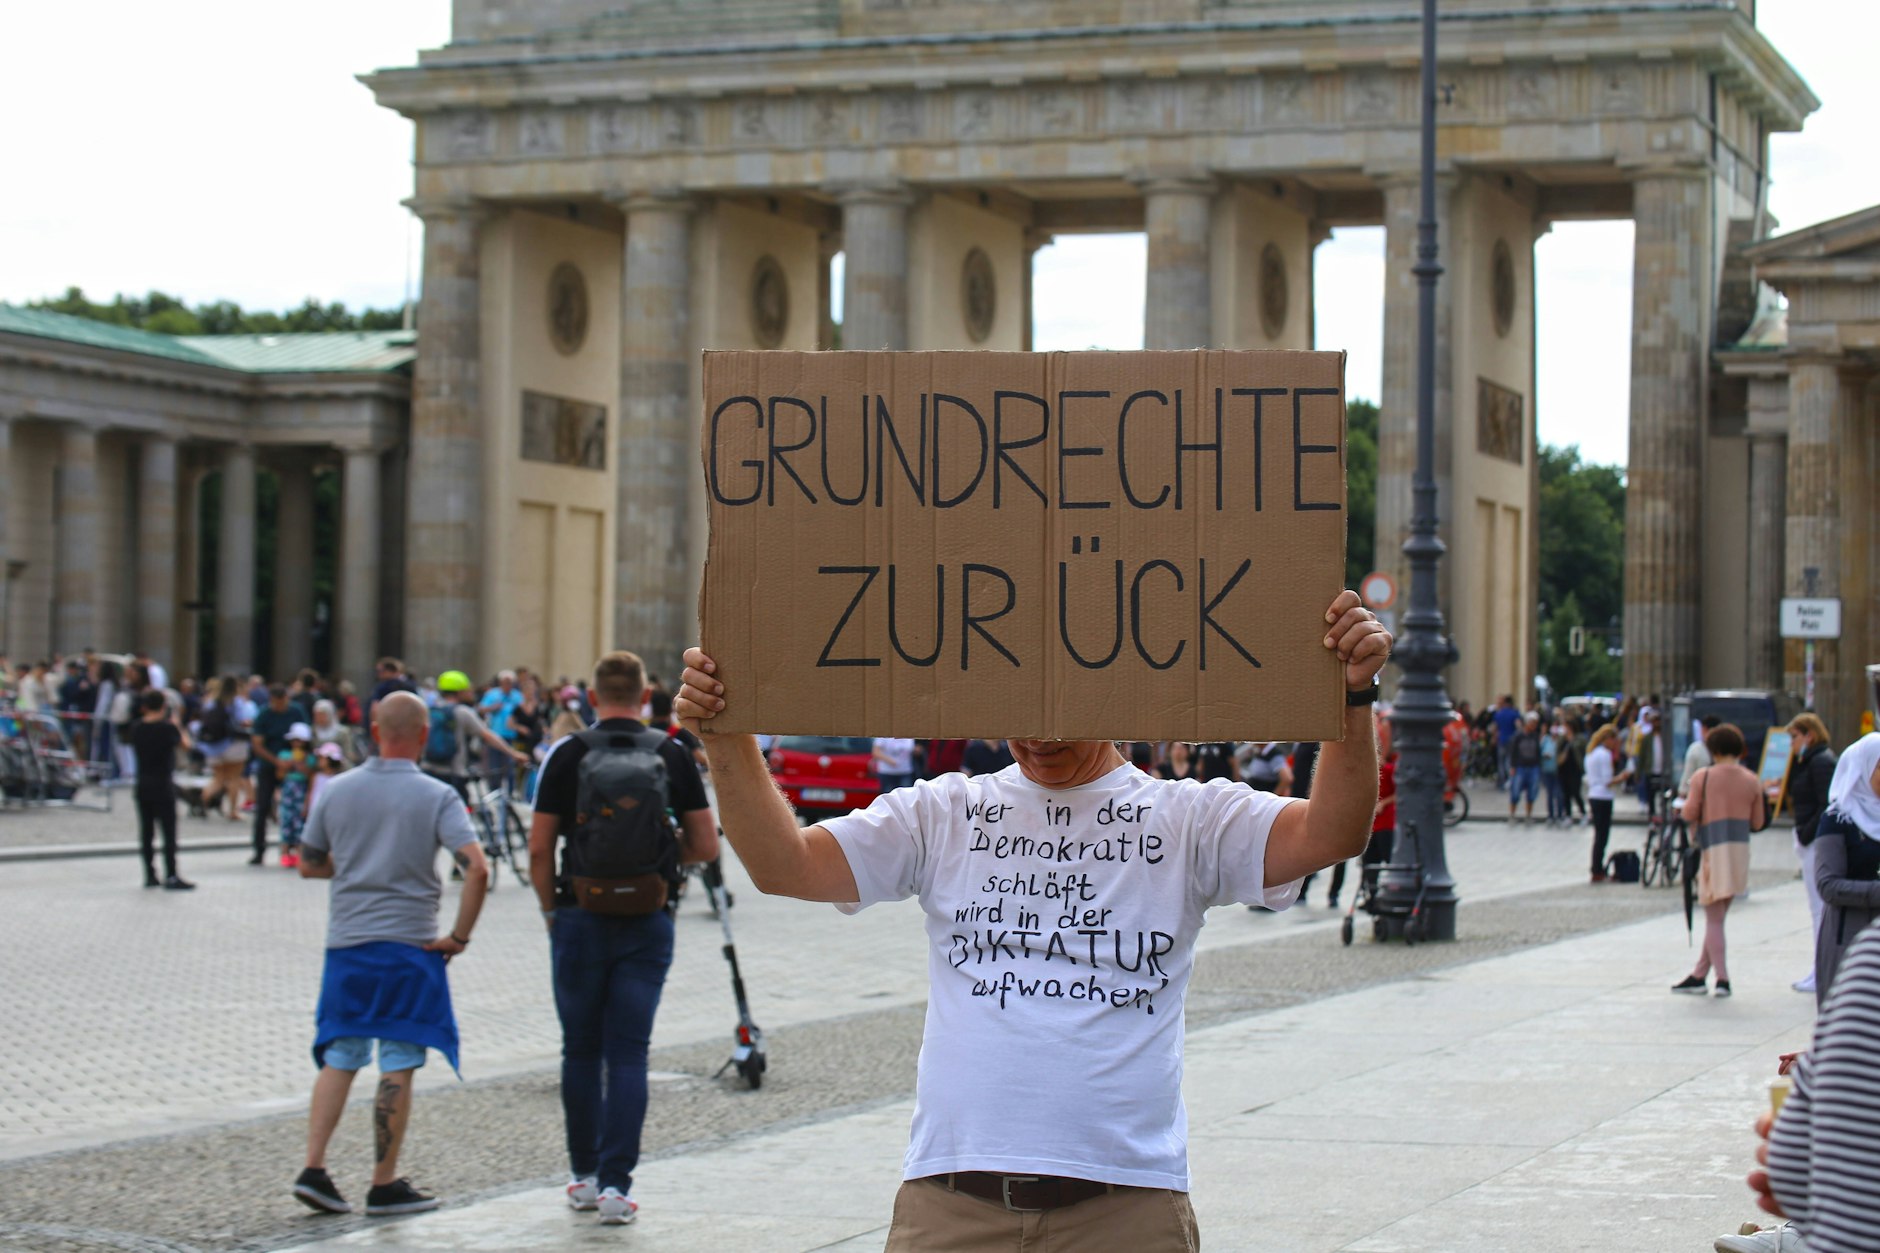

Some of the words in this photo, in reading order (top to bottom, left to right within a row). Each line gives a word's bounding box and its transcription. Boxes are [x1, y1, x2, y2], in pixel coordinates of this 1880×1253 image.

[710, 388, 1342, 511] GRUNDRECHTE
[1046, 799, 1071, 826] in
[1096, 798, 1152, 825] der
[969, 827, 1165, 864] Demokratie
[981, 871, 1098, 910] schläft
[955, 898, 1005, 923] wird
[1017, 905, 1040, 930] in
[1057, 905, 1113, 929] der
[949, 929, 1175, 977] DIKTATUR
